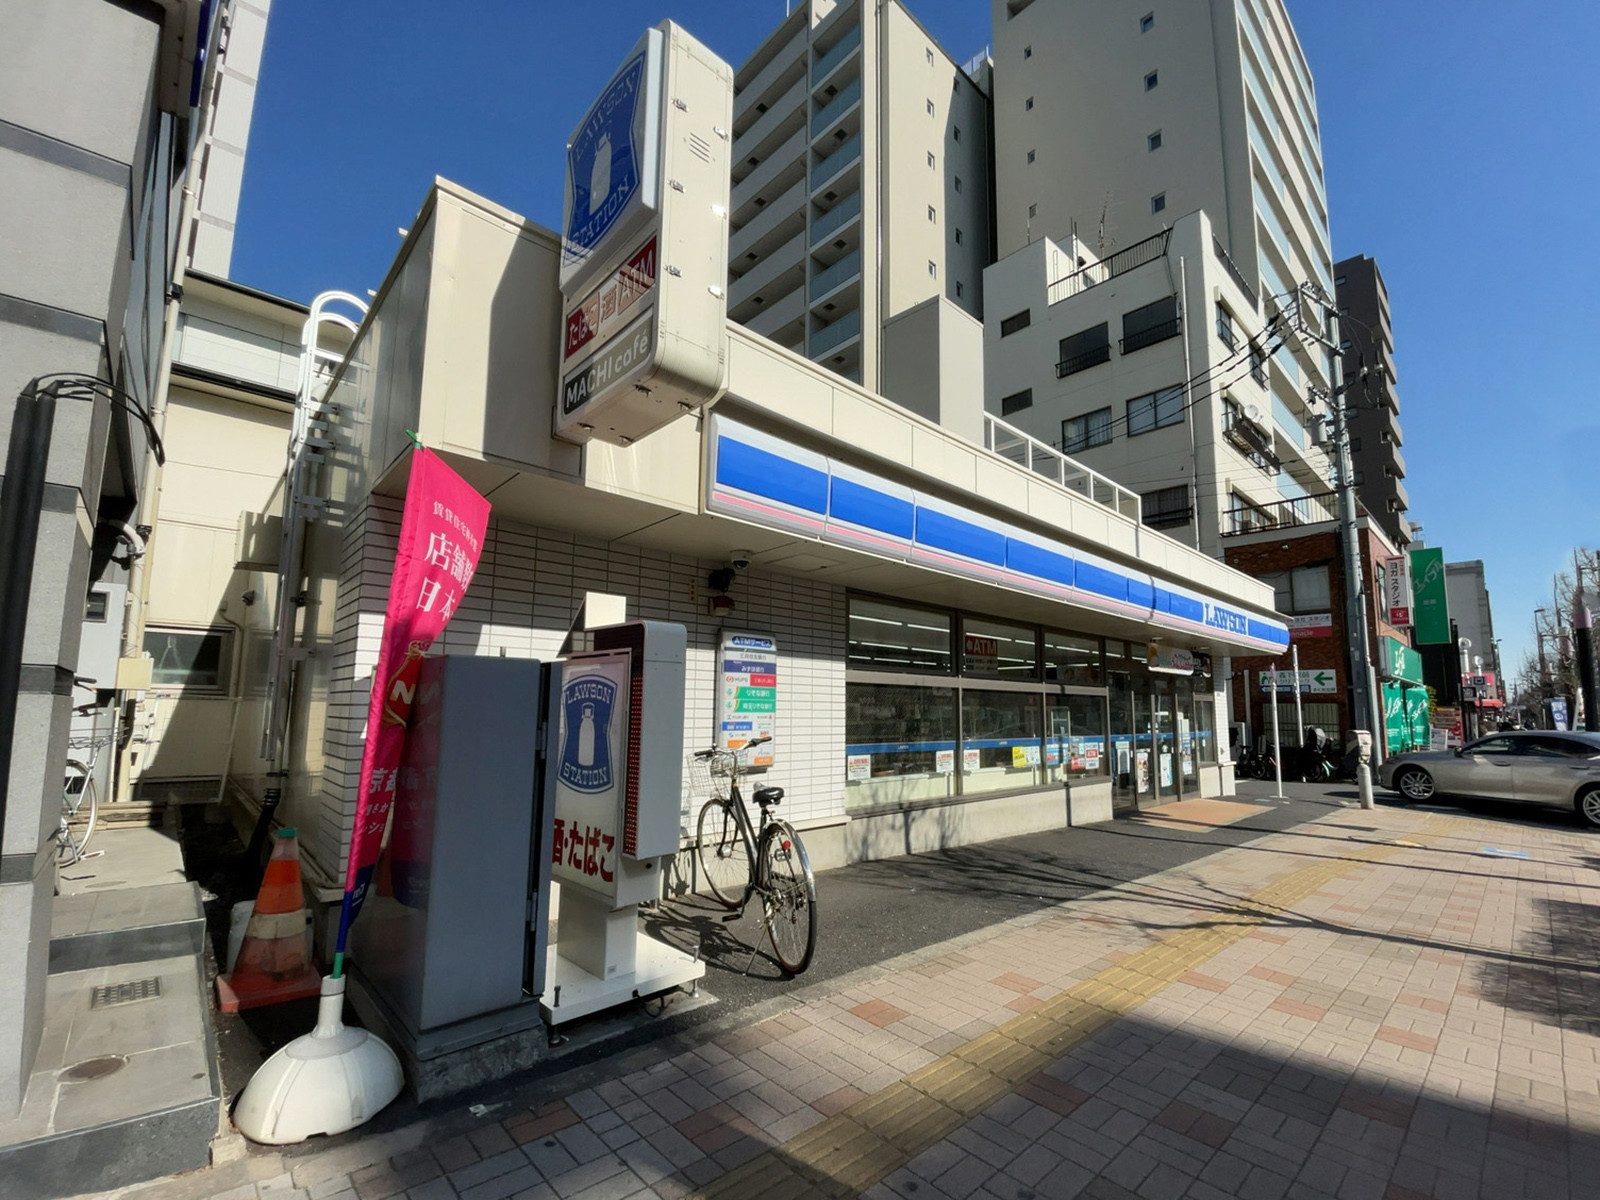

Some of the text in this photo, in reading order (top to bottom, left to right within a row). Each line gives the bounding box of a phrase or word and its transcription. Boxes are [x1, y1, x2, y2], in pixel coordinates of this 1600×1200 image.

[568, 303, 597, 349] たばこ
[621, 249, 654, 301] ATM
[566, 328, 649, 408] MACHI café
[1413, 558, 1444, 594] エイブル
[416, 577, 455, 622] 日本
[1204, 603, 1247, 635] LAWSON
[973, 638, 997, 655] ATM
[565, 683, 612, 706] LAWSON
[561, 764, 609, 787] STATION
